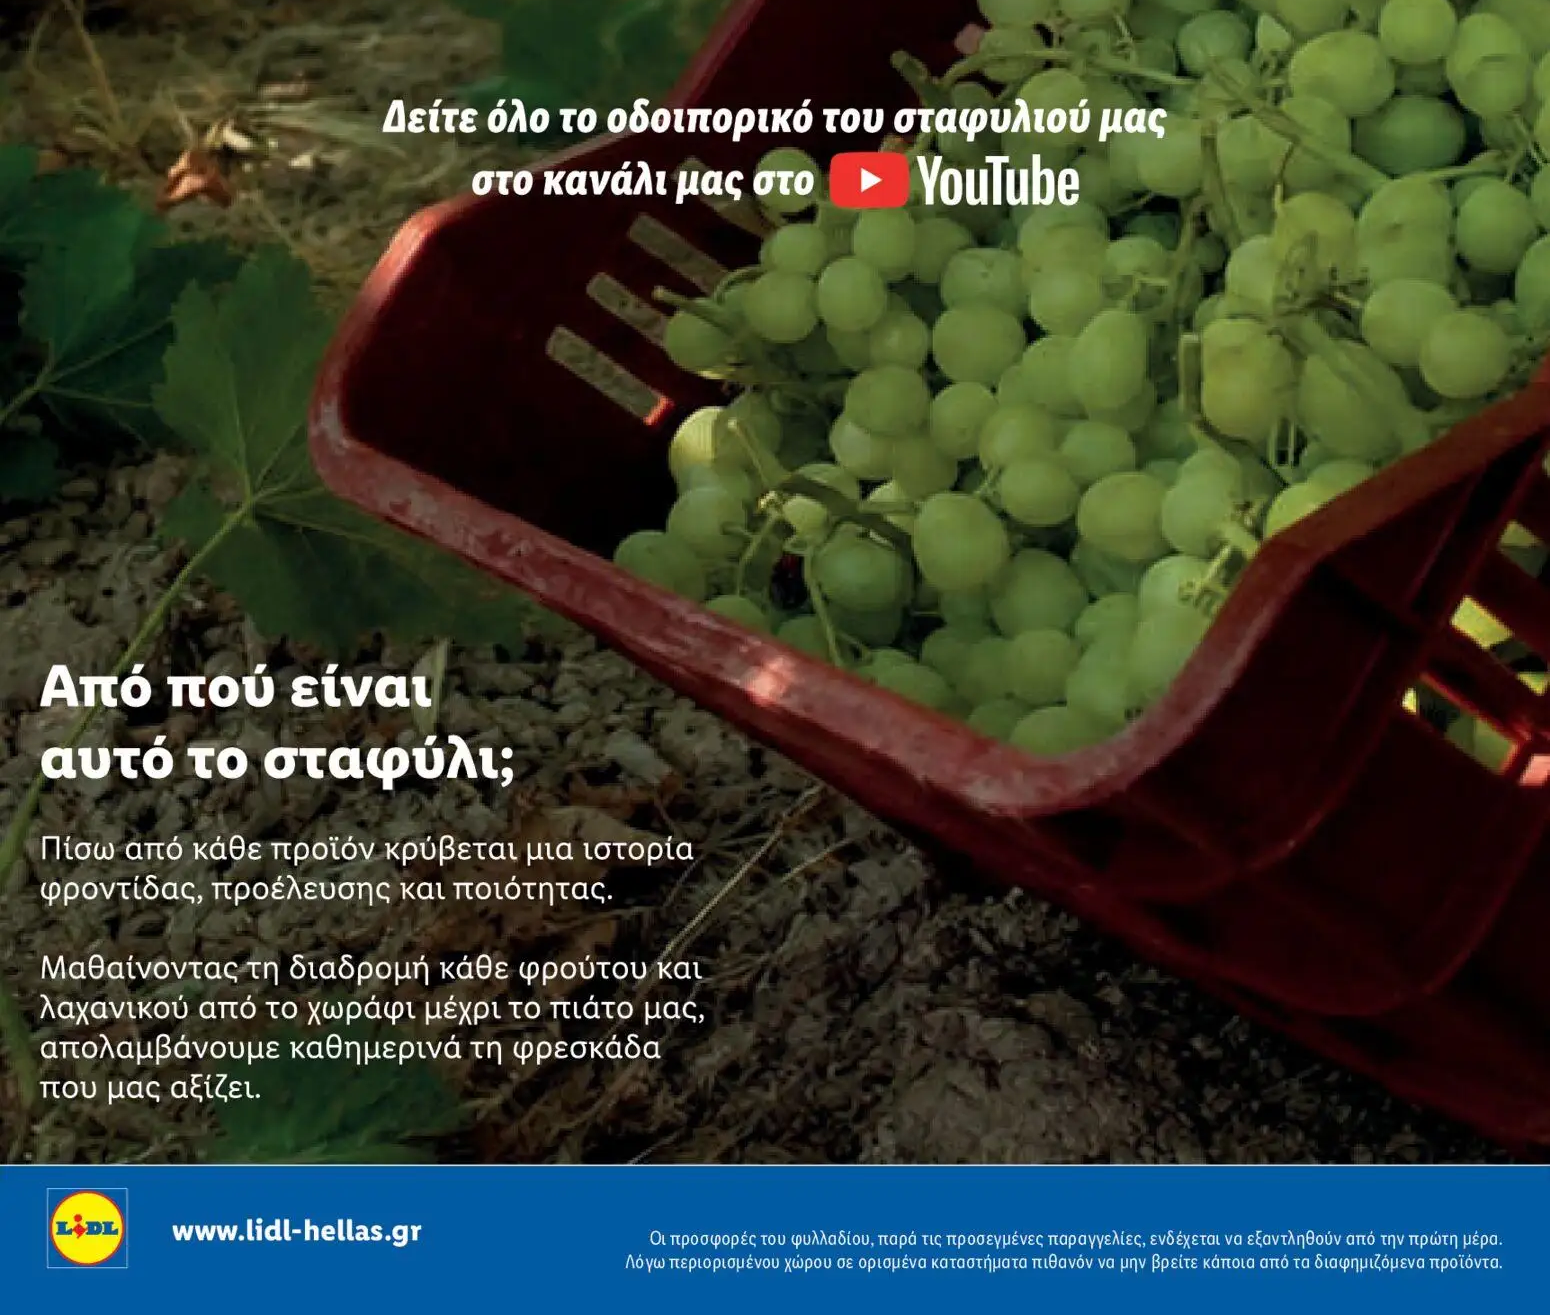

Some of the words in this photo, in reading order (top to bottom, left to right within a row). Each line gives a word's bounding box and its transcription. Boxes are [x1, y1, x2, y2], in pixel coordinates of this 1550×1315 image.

[383, 99, 478, 133] Δείτε
[488, 99, 549, 133] όλο
[560, 108, 597, 133] το
[608, 99, 812, 141] οδοιπορικό
[823, 109, 883, 133] του
[894, 98, 1090, 141] σταφυλιού
[1099, 108, 1167, 141] μας
[472, 171, 533, 195] στο
[544, 161, 666, 195] κανάλι
[676, 171, 743, 204] μας
[753, 171, 814, 195] στο
[917, 154, 1079, 205] YouTube
[41, 664, 151, 707] Από
[167, 664, 274, 707] πού
[292, 664, 431, 707] είναι
[42, 736, 173, 779] αυτό
[188, 747, 247, 778] το
[264, 735, 513, 790] σταφύλι;
[41, 836, 114, 860] Πίσω
[126, 836, 182, 860] από
[193, 835, 261, 860] κάθε
[271, 836, 374, 865] προϊόν
[385, 835, 517, 866] κρύβεται
[528, 843, 573, 866] μια
[584, 836, 693, 865] ιστορία
[41, 875, 202, 906] φροντίδας,
[212, 875, 389, 906] προέλευσης
[400, 882, 445, 899] και
[453, 876, 612, 905] ποιότητας.
[42, 955, 237, 985] Μαθαίνοντας
[247, 962, 278, 985] τη
[290, 955, 428, 985] διαδρομή
[440, 954, 508, 979] κάθε
[520, 955, 646, 985] φρούτου
[657, 962, 702, 979] και
[41, 995, 187, 1025] λαχανικού
[200, 995, 256, 1019] από
[266, 1002, 297, 1019] το
[308, 995, 415, 1025] χωράφι
[426, 995, 501, 1025] μέχρι
[509, 1002, 540, 1019] το
[550, 995, 633, 1019] πιάτο
[646, 1002, 704, 1025] μας,
[41, 1034, 279, 1065] απολαμβάνουμε
[290, 1034, 461, 1064] καθημερινά
[470, 1041, 501, 1064] τη
[514, 1034, 660, 1065] φρεσκάδα
[40, 1081, 96, 1098] που
[109, 1081, 159, 1104] μας
[171, 1074, 260, 1104] αξίζει.
[173, 1218, 421, 1247] www.lidl-hellas.gr
[649, 1230, 665, 1245] Οι
[670, 1230, 756, 1249] προσφορές
[761, 1235, 785, 1245] του
[791, 1230, 874, 1249] φυλλαδίου,
[878, 1230, 916, 1249] παρά
[922, 1235, 941, 1249] τις
[947, 1230, 1043, 1249] προσεγμένες
[1048, 1230, 1145, 1249] παραγγελίες,
[1151, 1230, 1220, 1249] ενδέχεται
[1225, 1235, 1242, 1245] να
[1248, 1230, 1341, 1249] εξαντληθούν
[1347, 1230, 1375, 1245] από
[1380, 1235, 1404, 1249] την
[1409, 1230, 1457, 1249] πρώτη
[1463, 1230, 1502, 1249] μέρα.
[625, 1254, 664, 1272] Λόγω
[669, 1254, 779, 1272] περιορισμένου
[785, 1254, 831, 1272] χώρου
[838, 1258, 852, 1269] σε
[859, 1254, 926, 1272] ορισμένα
[932, 1254, 1026, 1272] καταστήματα
[1032, 1254, 1092, 1269] πιθανόν
[1098, 1258, 1114, 1269] να
[1121, 1258, 1145, 1272] μην
[1152, 1254, 1198, 1272] βρείτε
[1204, 1254, 1254, 1269] κάποια
[1260, 1254, 1288, 1269] από
[1294, 1258, 1309, 1269] τα
[1315, 1254, 1424, 1272] διαφημιζόμενα
[1430, 1254, 1502, 1272] προϊόντα.
